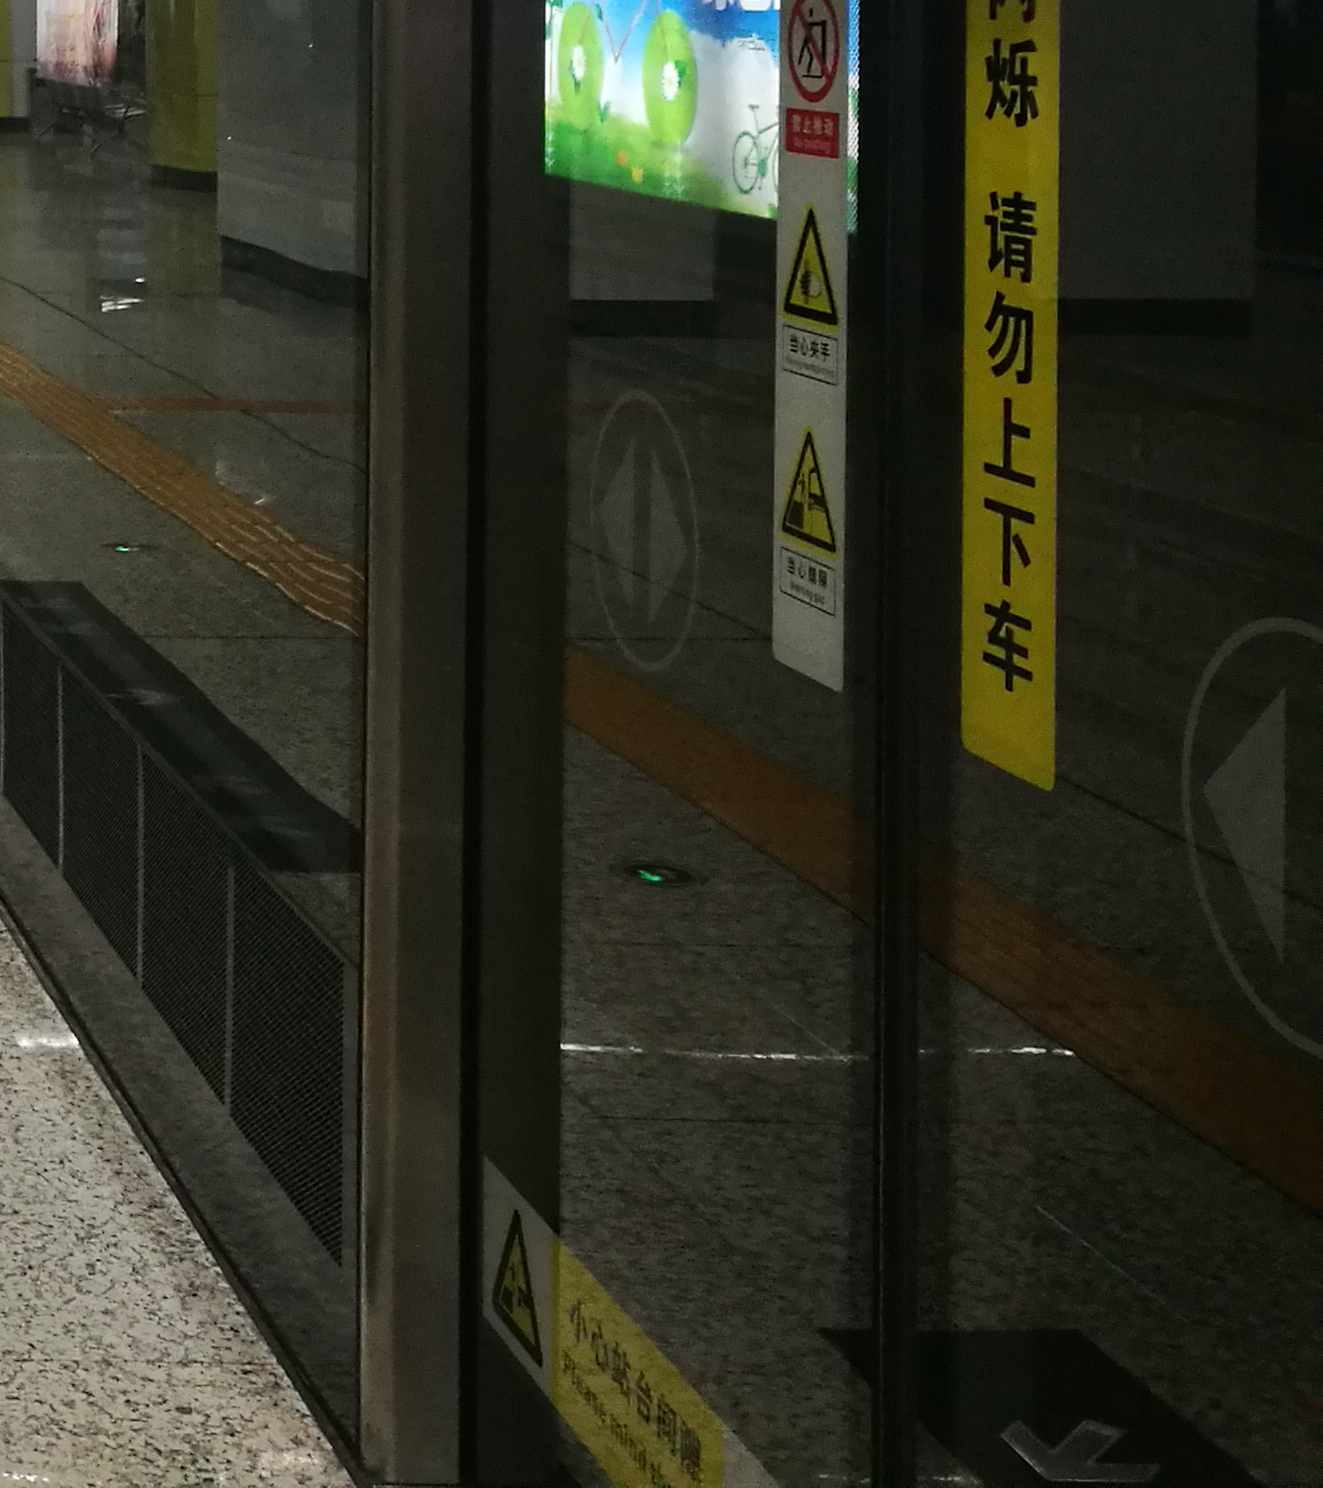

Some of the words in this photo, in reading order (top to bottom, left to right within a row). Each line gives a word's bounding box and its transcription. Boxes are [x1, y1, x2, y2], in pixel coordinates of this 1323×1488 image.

[982, 191, 1038, 693] 请勿上下车
